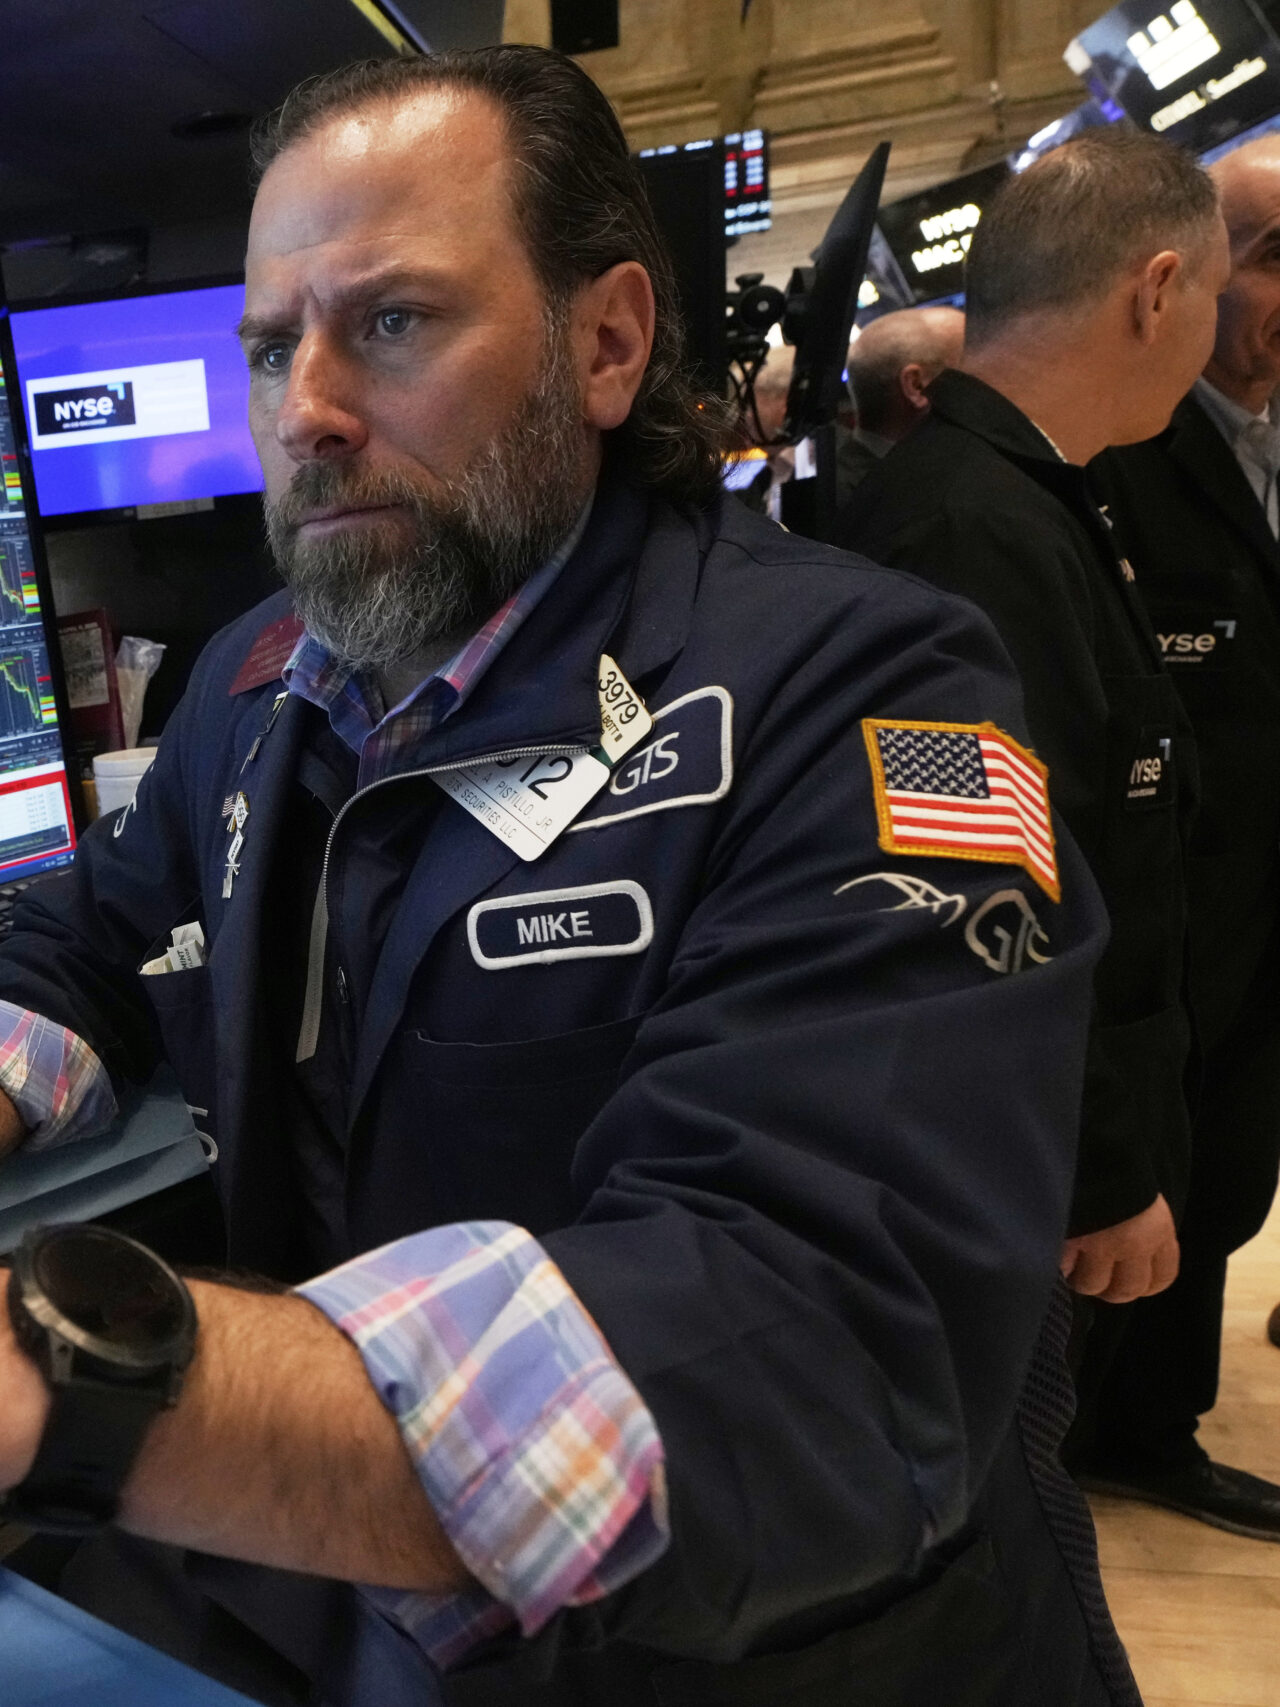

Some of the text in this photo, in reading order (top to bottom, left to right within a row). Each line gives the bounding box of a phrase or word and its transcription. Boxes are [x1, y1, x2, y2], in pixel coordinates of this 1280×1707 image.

[54, 397, 113, 421] NYSE
[1157, 634, 1215, 652] YSE
[599, 671, 638, 724] 3979
[610, 732, 680, 795] GTS
[460, 788, 500, 825] SECURITIES
[500, 821, 517, 839] LLC
[536, 816, 553, 832] JR
[517, 911, 592, 944] MIKE
